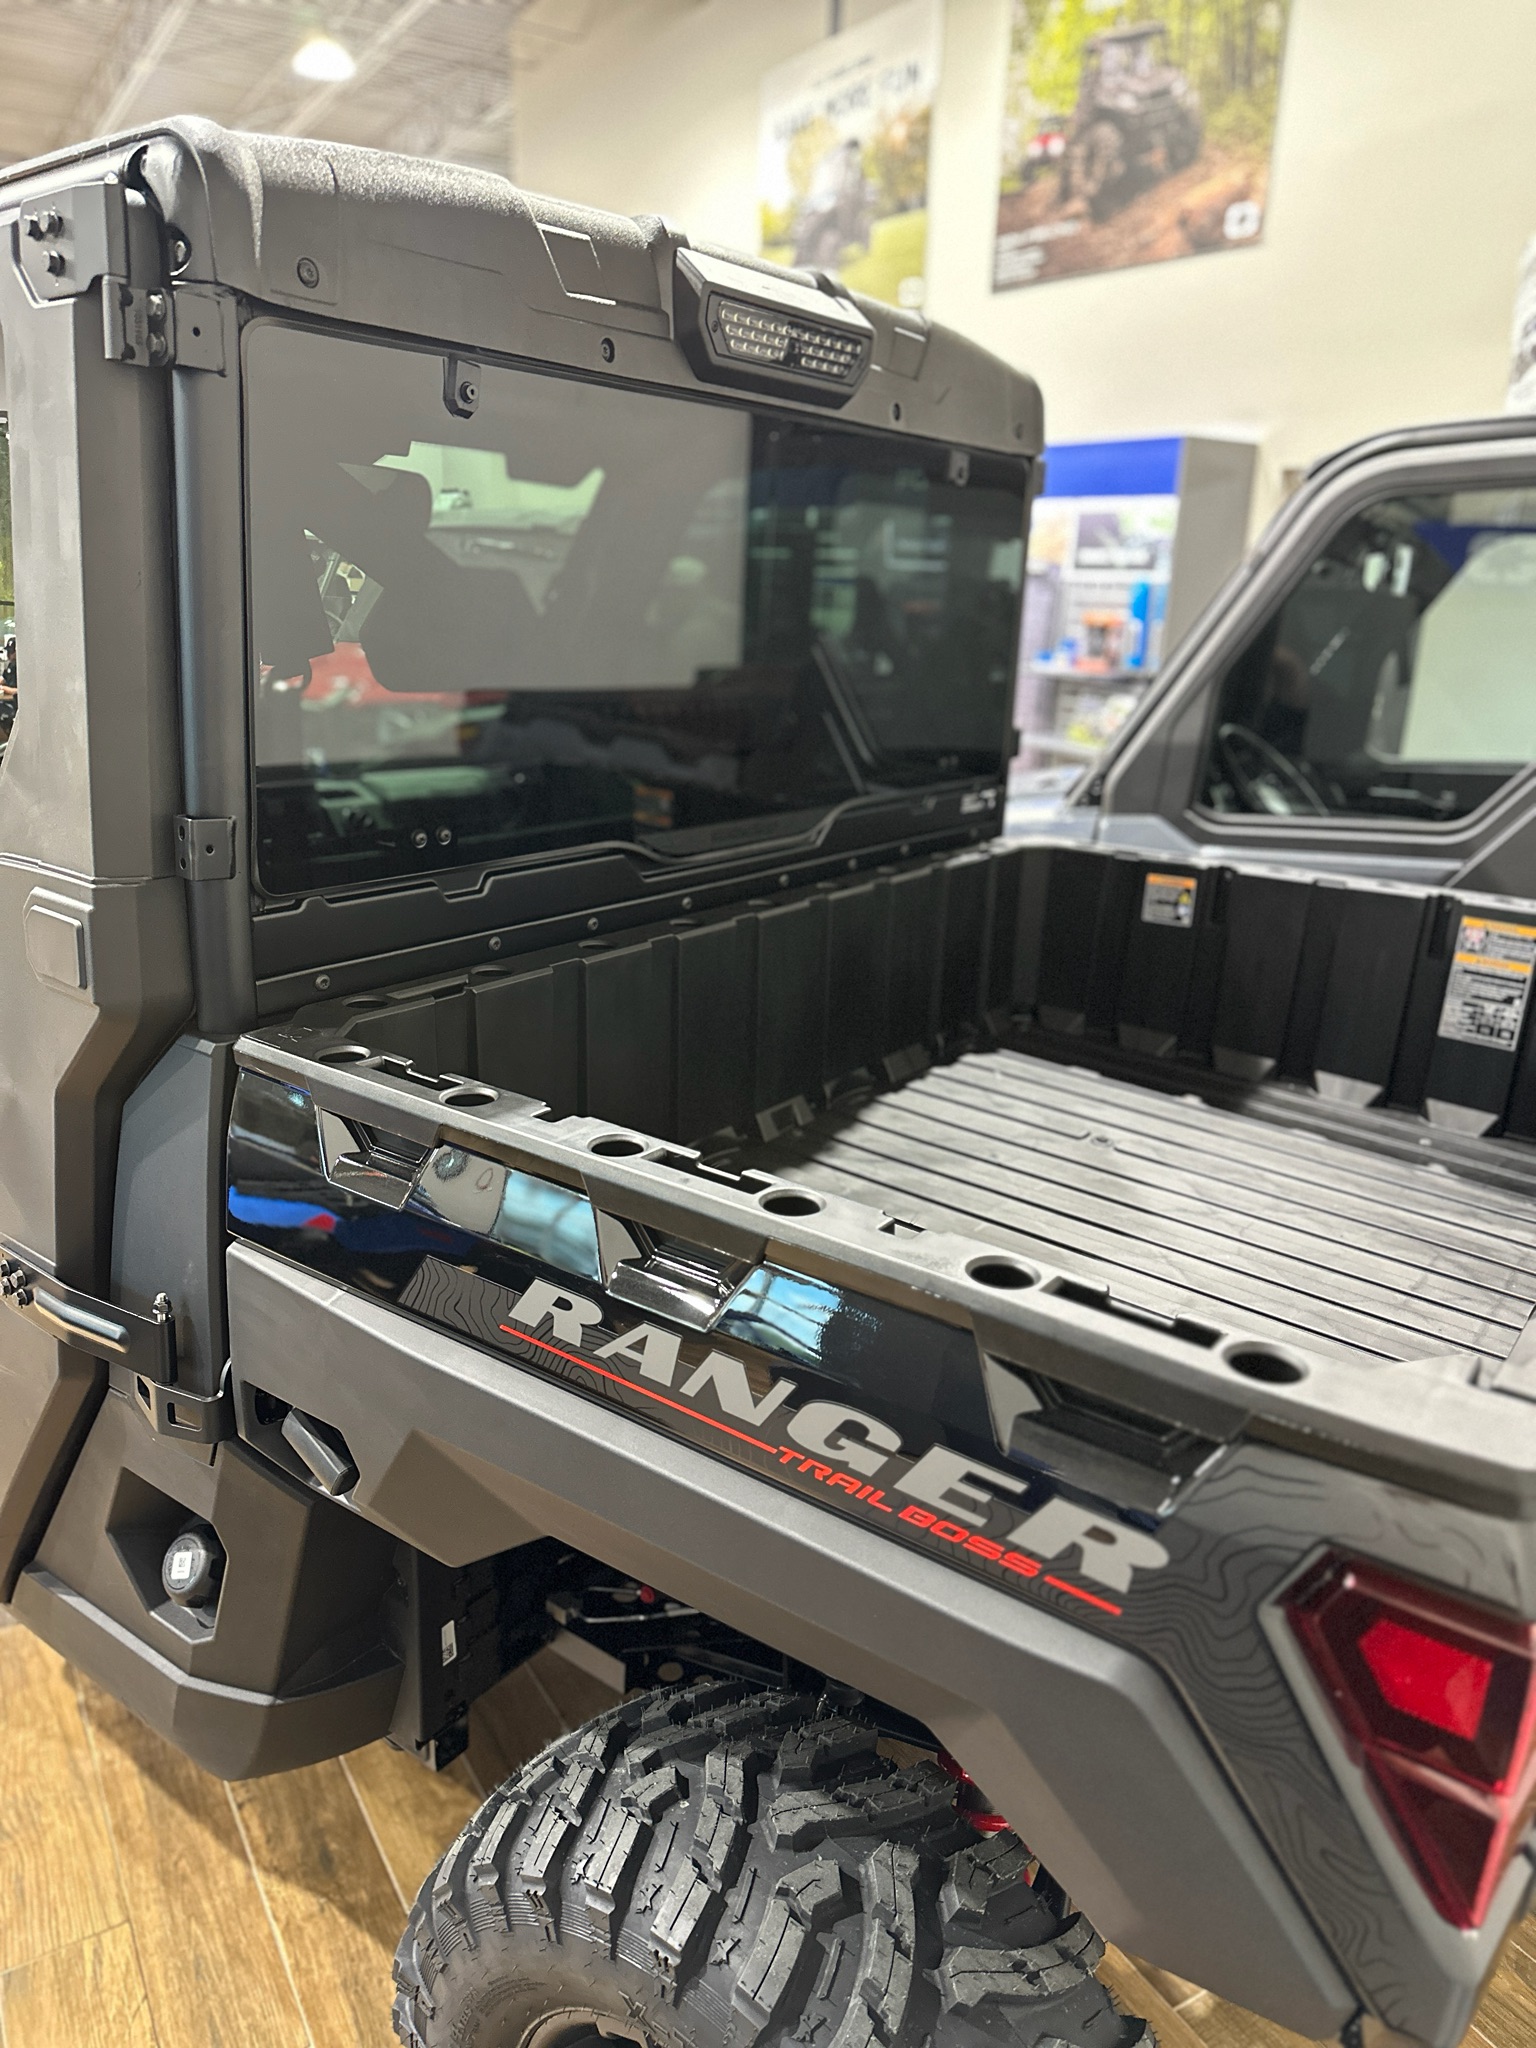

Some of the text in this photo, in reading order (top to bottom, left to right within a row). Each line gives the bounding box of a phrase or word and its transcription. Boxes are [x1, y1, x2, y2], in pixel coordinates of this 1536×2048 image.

[508, 1277, 1169, 1593] RANGER
[779, 1446, 1042, 1577] TRAIL BOSS
